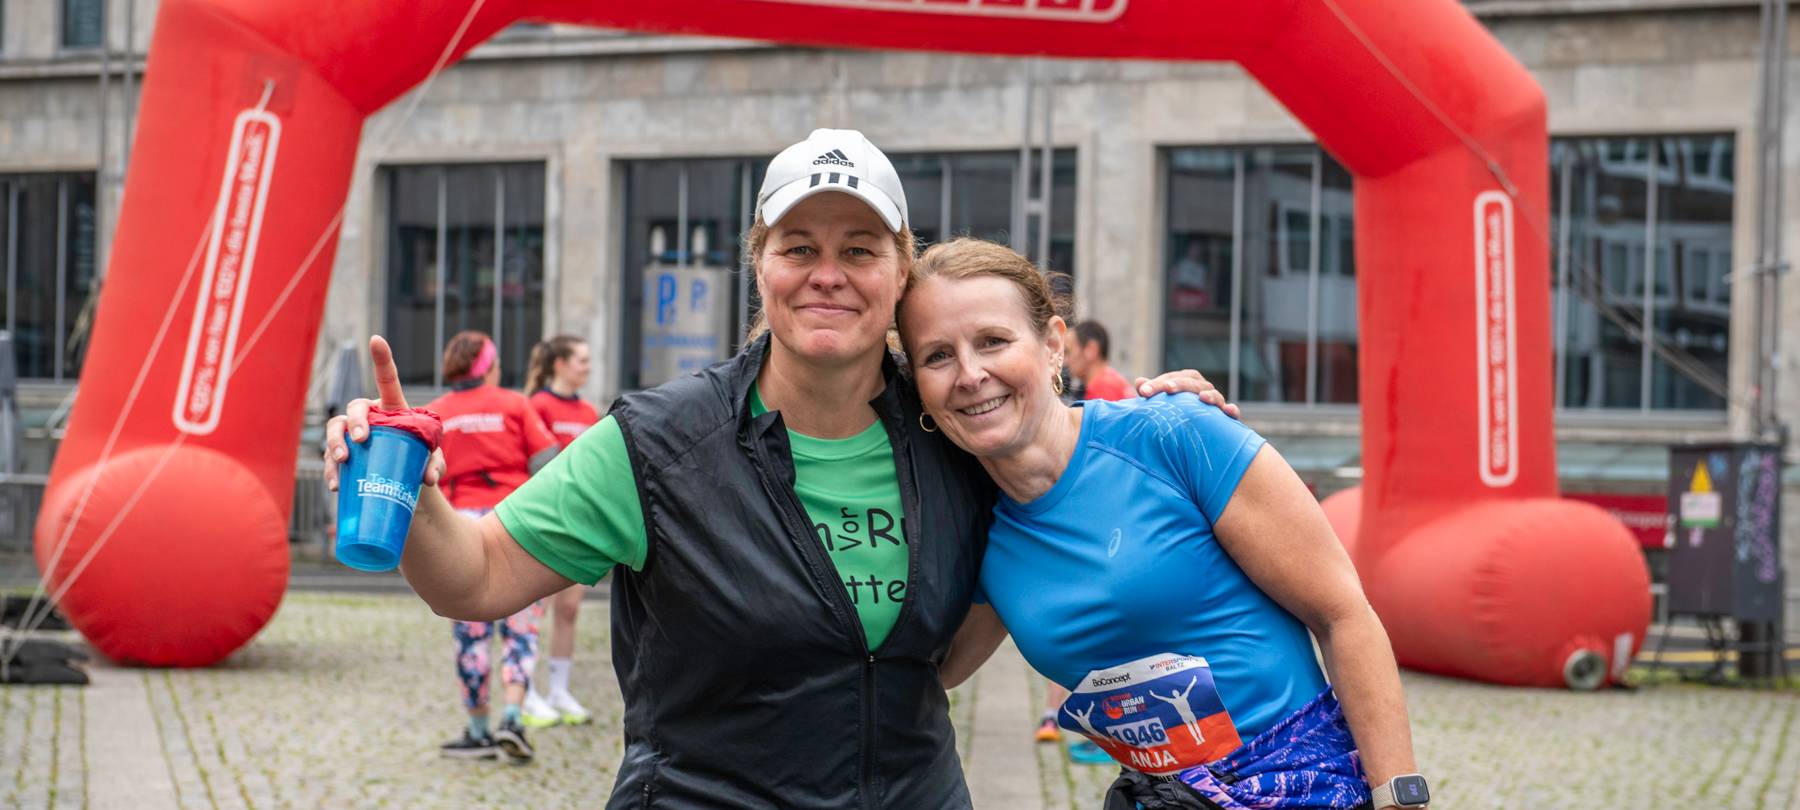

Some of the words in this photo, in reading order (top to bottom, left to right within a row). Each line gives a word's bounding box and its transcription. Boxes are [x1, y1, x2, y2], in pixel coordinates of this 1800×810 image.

[813, 157, 855, 168] adidas
[1092, 673, 1131, 687] BoConcept
[1121, 695, 1145, 707] URBAN
[1123, 706, 1138, 715] RUN
[1112, 722, 1166, 746] 1946
[1129, 750, 1178, 768] ANJA
